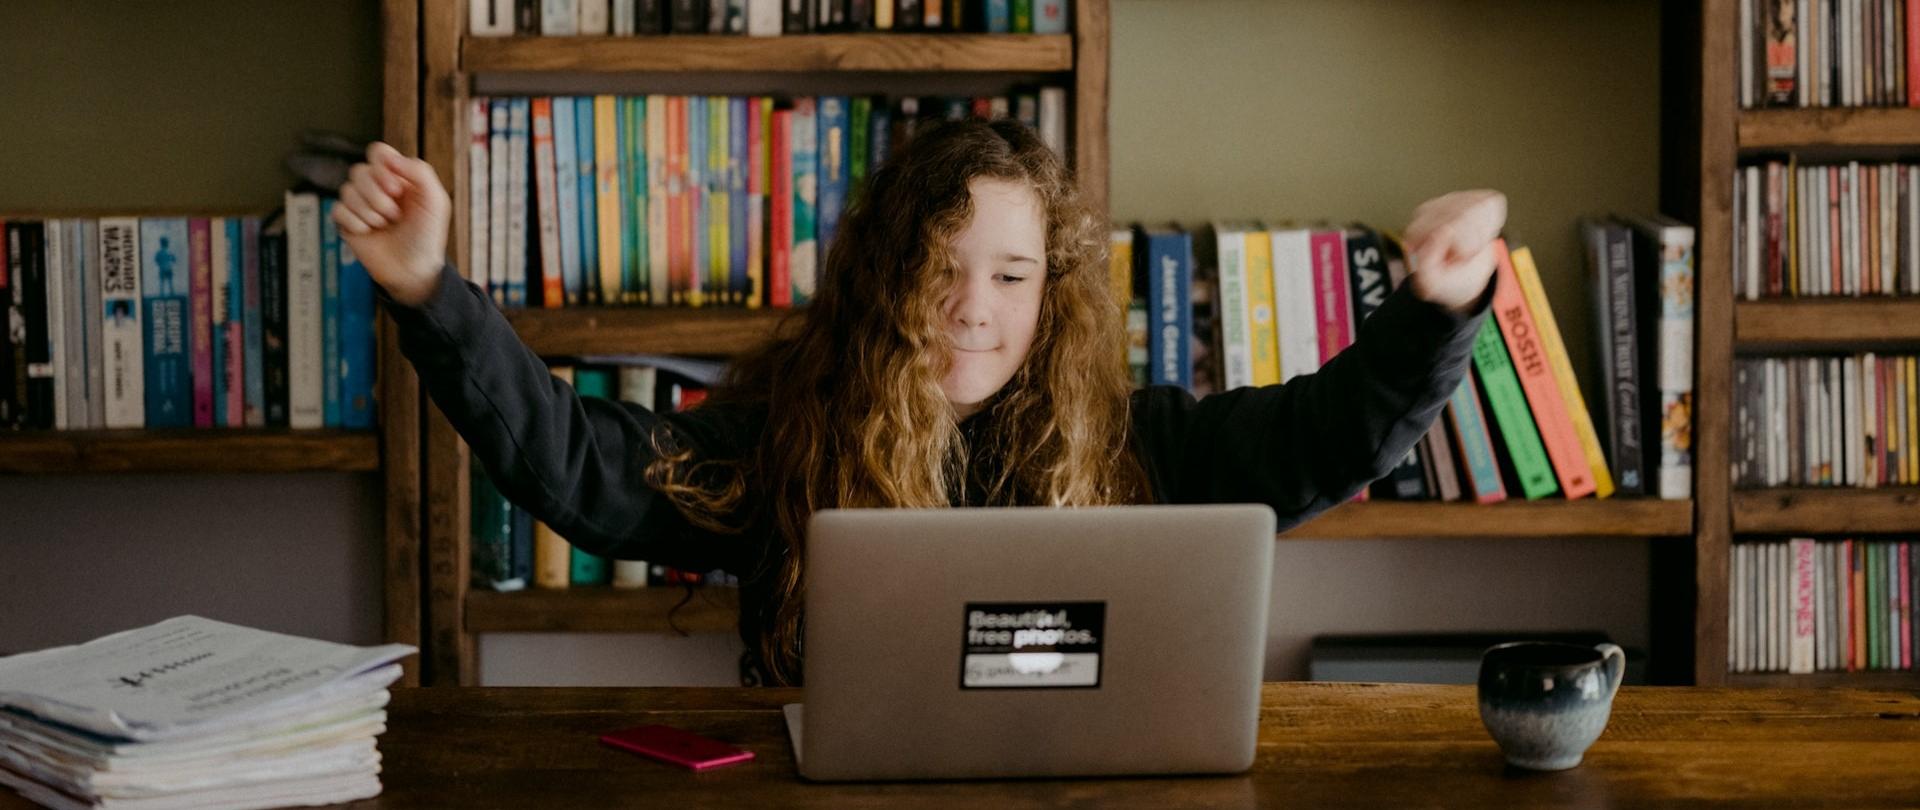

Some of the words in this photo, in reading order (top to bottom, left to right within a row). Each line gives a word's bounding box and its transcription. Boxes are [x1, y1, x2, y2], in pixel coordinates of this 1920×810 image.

[103, 226, 121, 293] MARKS
[122, 227, 135, 291] HOWARD
[1354, 247, 1386, 320] SAV
[166, 299, 183, 355] EUROPE
[1506, 306, 1543, 376] BOSH!
[1615, 335, 1633, 379] TRUST
[967, 629, 1012, 645] free
[1013, 629, 1097, 650] photos.
